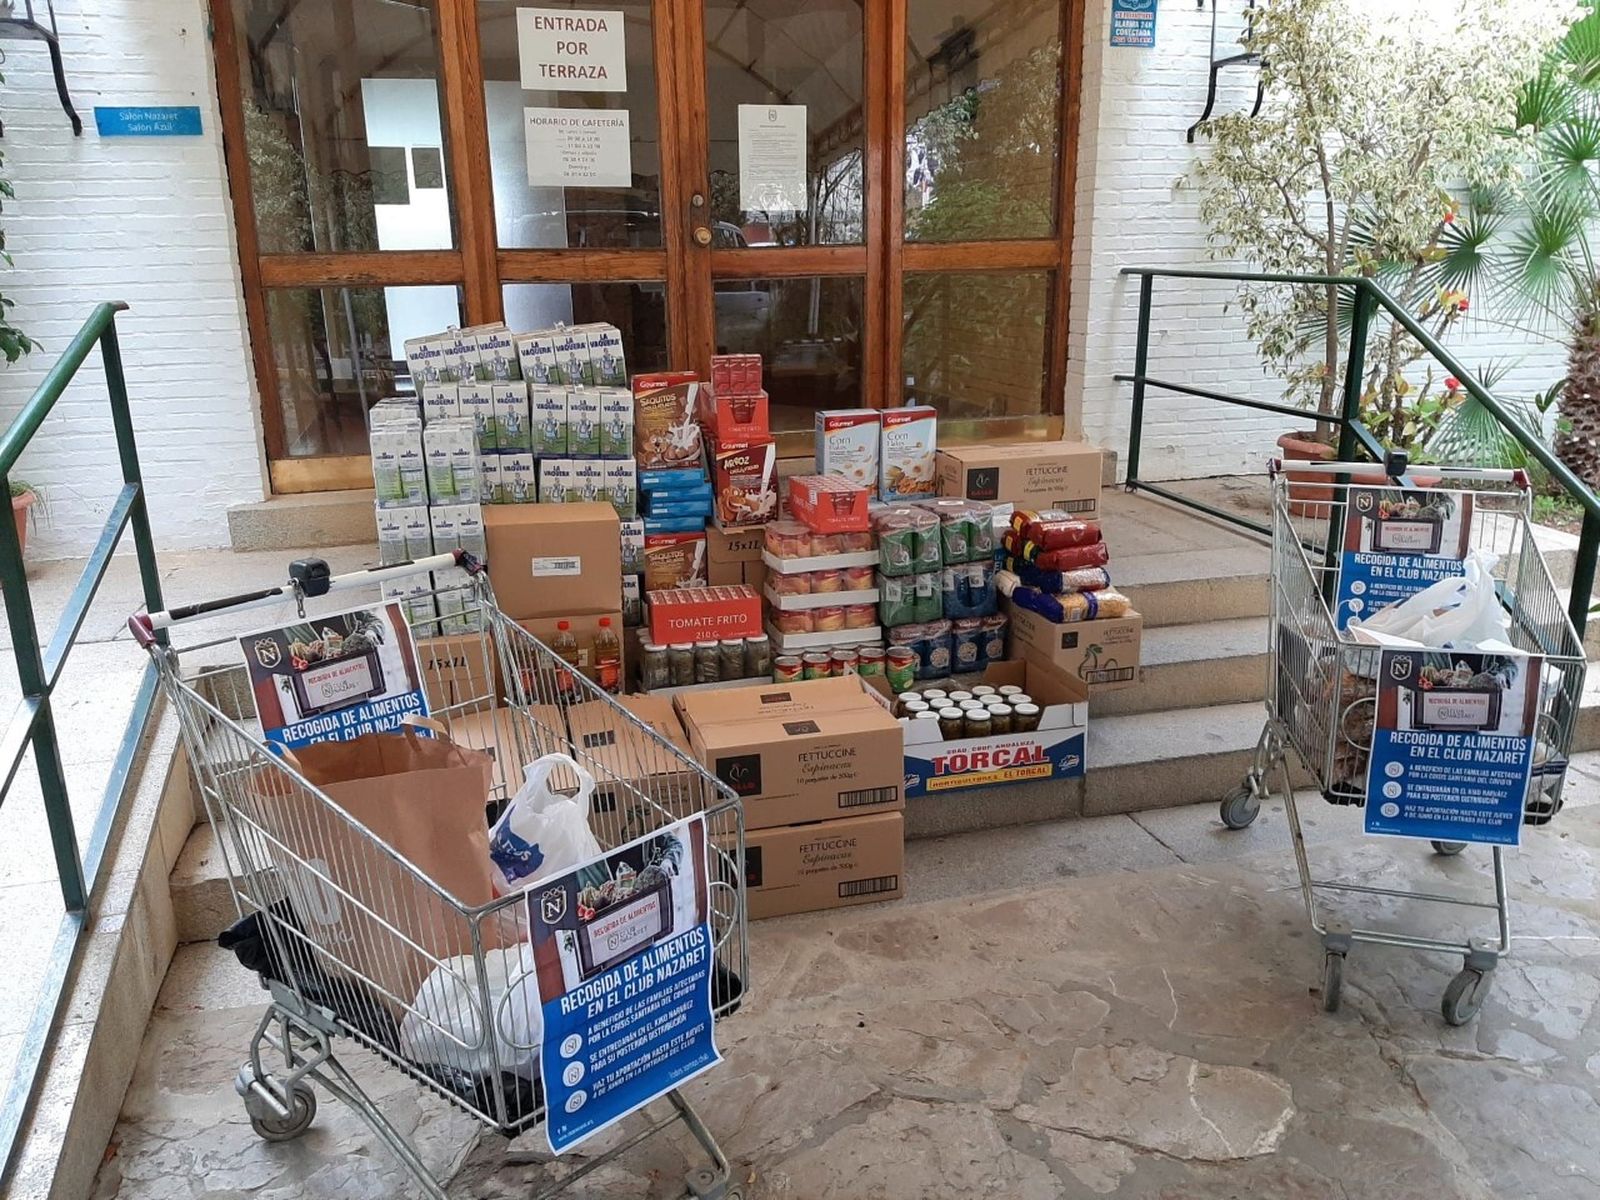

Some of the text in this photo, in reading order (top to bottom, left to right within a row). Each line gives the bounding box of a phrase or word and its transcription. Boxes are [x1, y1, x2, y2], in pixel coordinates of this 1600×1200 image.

[534, 15, 609, 33] ENTRADA
[556, 41, 588, 56] POR
[538, 63, 608, 80] TERRAZA
[529, 118, 568, 126] HORARIO
[444, 345, 476, 356] VAQUERA
[479, 340, 511, 351] VAQUERA
[555, 342, 586, 352] VAQUERA
[590, 338, 620, 348] VAQUERA
[409, 349, 441, 361] VAQUERA
[520, 346, 552, 357] VAQUERA
[886, 416, 912, 424] Gourmet
[886, 431, 909, 441] Corn
[720, 442, 749, 450] Gourmet
[723, 455, 750, 470] ARROZ
[1354, 553, 1463, 571] RECOGIDA DE ALIMENTOS
[1370, 565, 1382, 577] EN
[1384, 567, 1395, 577] EL
[1396, 567, 1419, 580] CLUB
[668, 613, 748, 629] TOMATE FRITO
[695, 631, 711, 640] 210
[281, 690, 420, 743] RECOGIDA DE ALIMENTOS
[1389, 730, 1527, 751] RECOGIDA DE ALIMENTOS
[798, 747, 857, 762] FETTUCCINE
[931, 745, 1050, 775] TORCAL
[1409, 745, 1525, 765] EN EL CLUB NAZARET
[1015, 766, 1048, 777] TORCAL
[799, 838, 857, 854] FETTUCCINE
[559, 925, 706, 1016] RECOGIDA DE ALIMENTOS
[586, 945, 706, 1020] EN EL CLUB NAZARET
[587, 1026, 593, 1036] A
[625, 1004, 633, 1016] DE
[633, 998, 646, 1011] LAS
[587, 1031, 601, 1045] POR
[601, 1025, 610, 1038] LA
[610, 1015, 630, 1034] CRISIS
[588, 1051, 598, 1064] SE
[637, 1025, 646, 1037] EN
[646, 1020, 654, 1032] EL
[606, 1071, 614, 1084] TU
[669, 1032, 684, 1048] ESTE
[607, 1051, 616, 1064] SU
